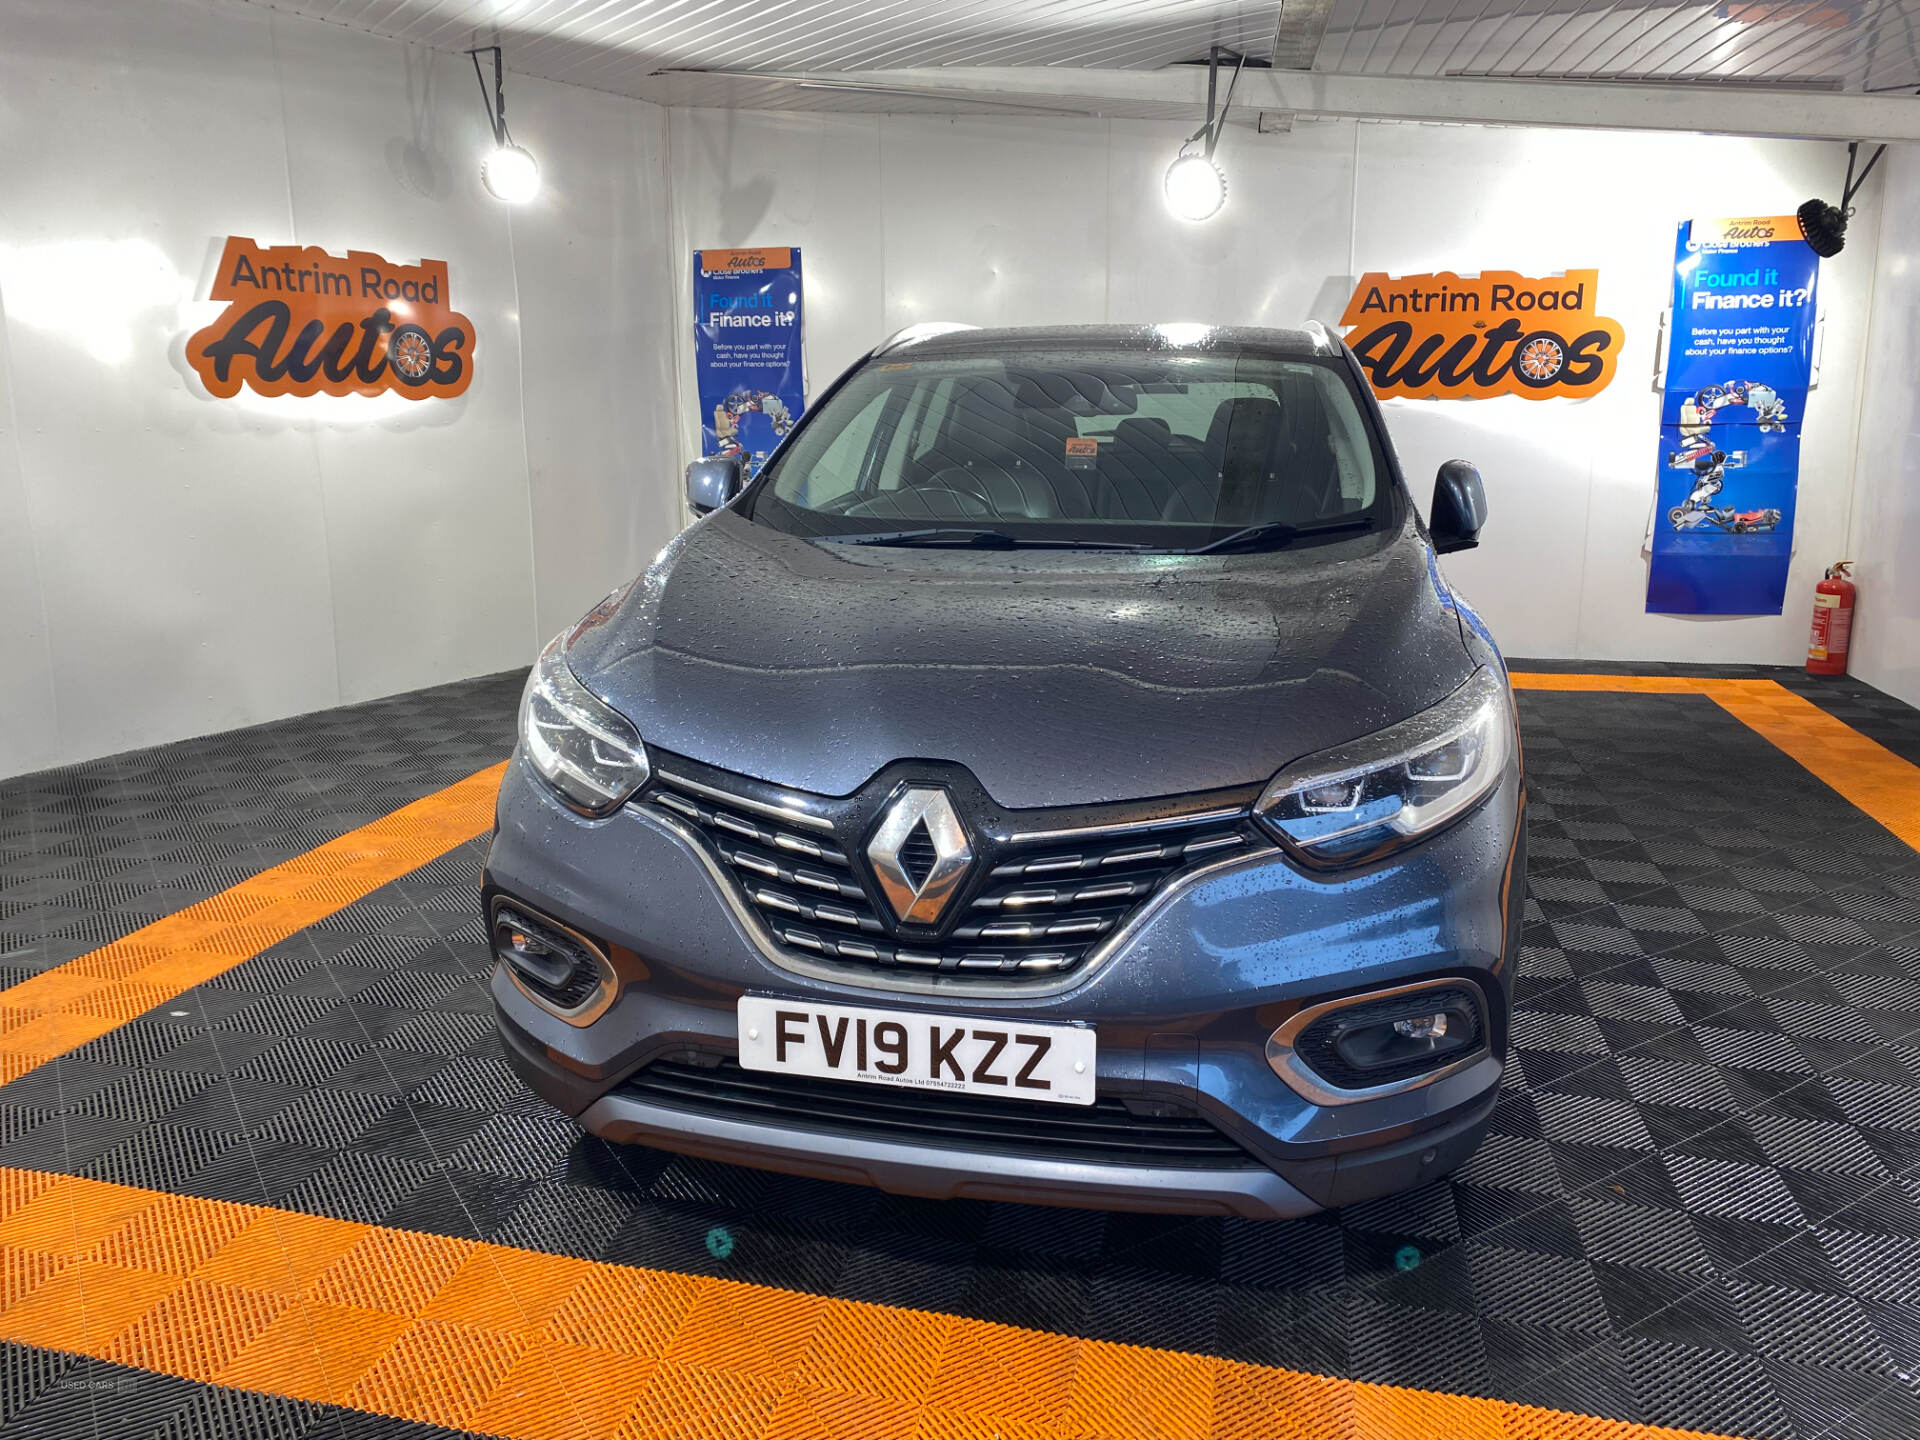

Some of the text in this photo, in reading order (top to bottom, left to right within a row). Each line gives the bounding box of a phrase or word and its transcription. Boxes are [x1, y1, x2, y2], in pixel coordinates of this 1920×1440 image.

[1722, 226, 1775, 239] Autos
[728, 255, 766, 268] Autos
[231, 254, 439, 304] Antrim Road
[1694, 268, 1779, 288] Found it
[709, 292, 773, 309] Found it
[1360, 282, 1584, 313] Antrim Road
[1692, 288, 1808, 310] Finance it?
[709, 311, 795, 328] Finance it?
[1735, 328, 1751, 336] part
[1753, 326, 1769, 334] with
[1771, 327, 1790, 335] your
[202, 300, 465, 387] Autos
[773, 343, 787, 351] your
[1694, 336, 1785, 346] cash, have you thought
[761, 351, 784, 359] thought
[1349, 318, 1611, 388] Autos
[1685, 346, 1793, 356] about your finance options?
[766, 360, 790, 369] options?
[775, 1010, 1052, 1090] FV19 KZZ
